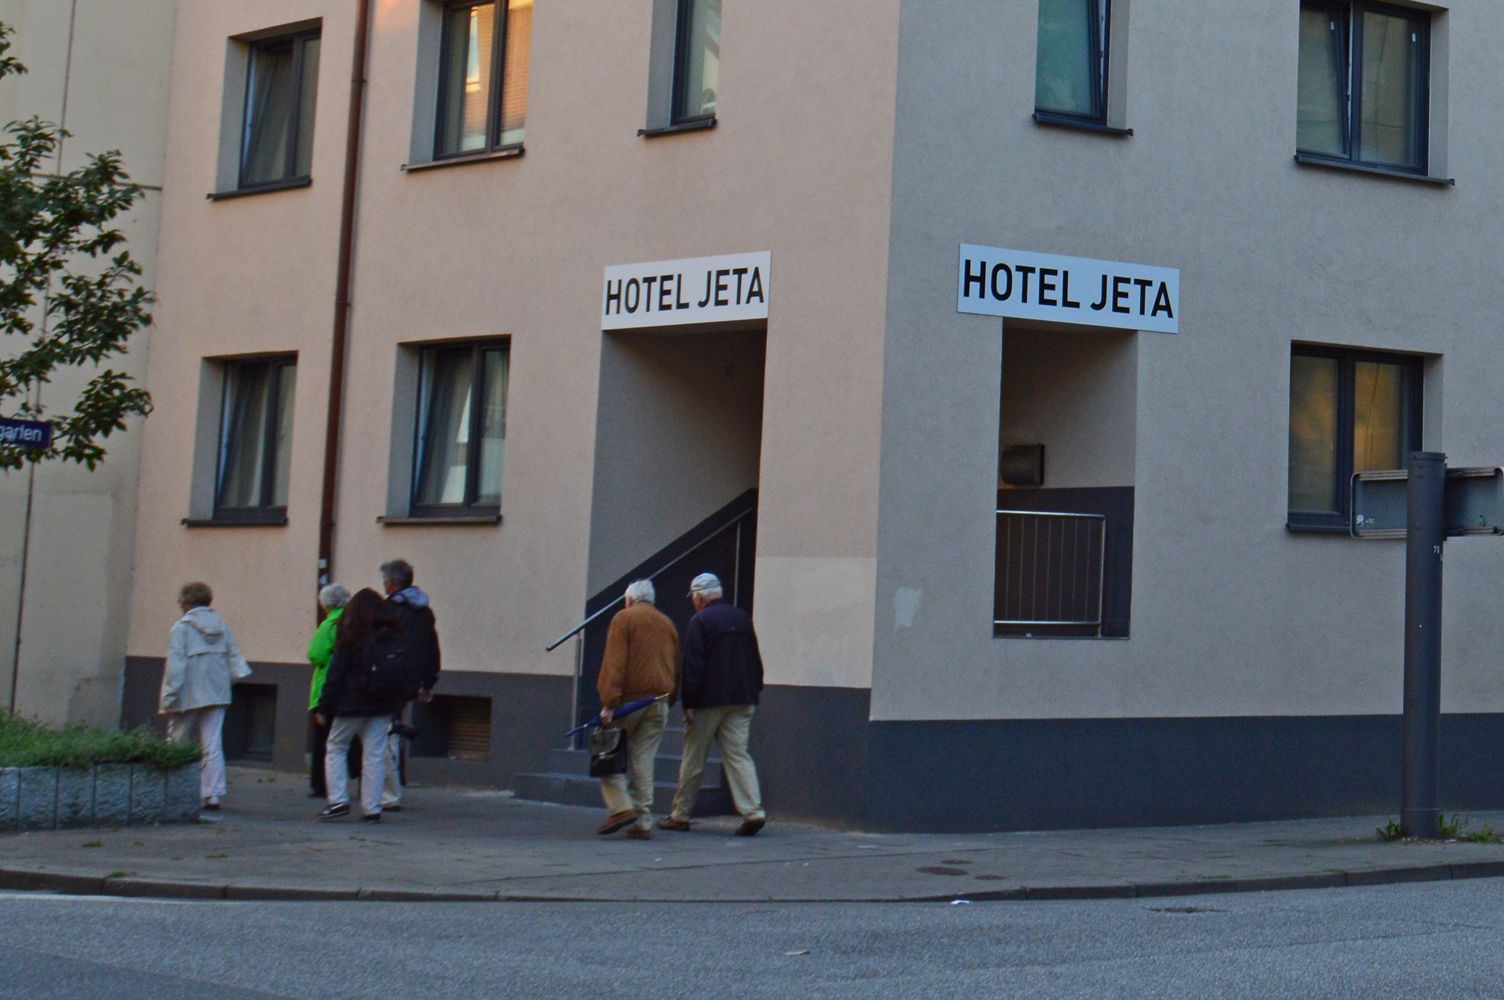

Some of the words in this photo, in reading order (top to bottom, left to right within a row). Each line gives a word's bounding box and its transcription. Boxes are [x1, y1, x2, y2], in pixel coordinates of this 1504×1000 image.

[605, 273, 690, 315] HOTEL
[697, 266, 765, 308] JETA
[963, 259, 1080, 309] HOTEL
[1090, 274, 1174, 319] JETA
